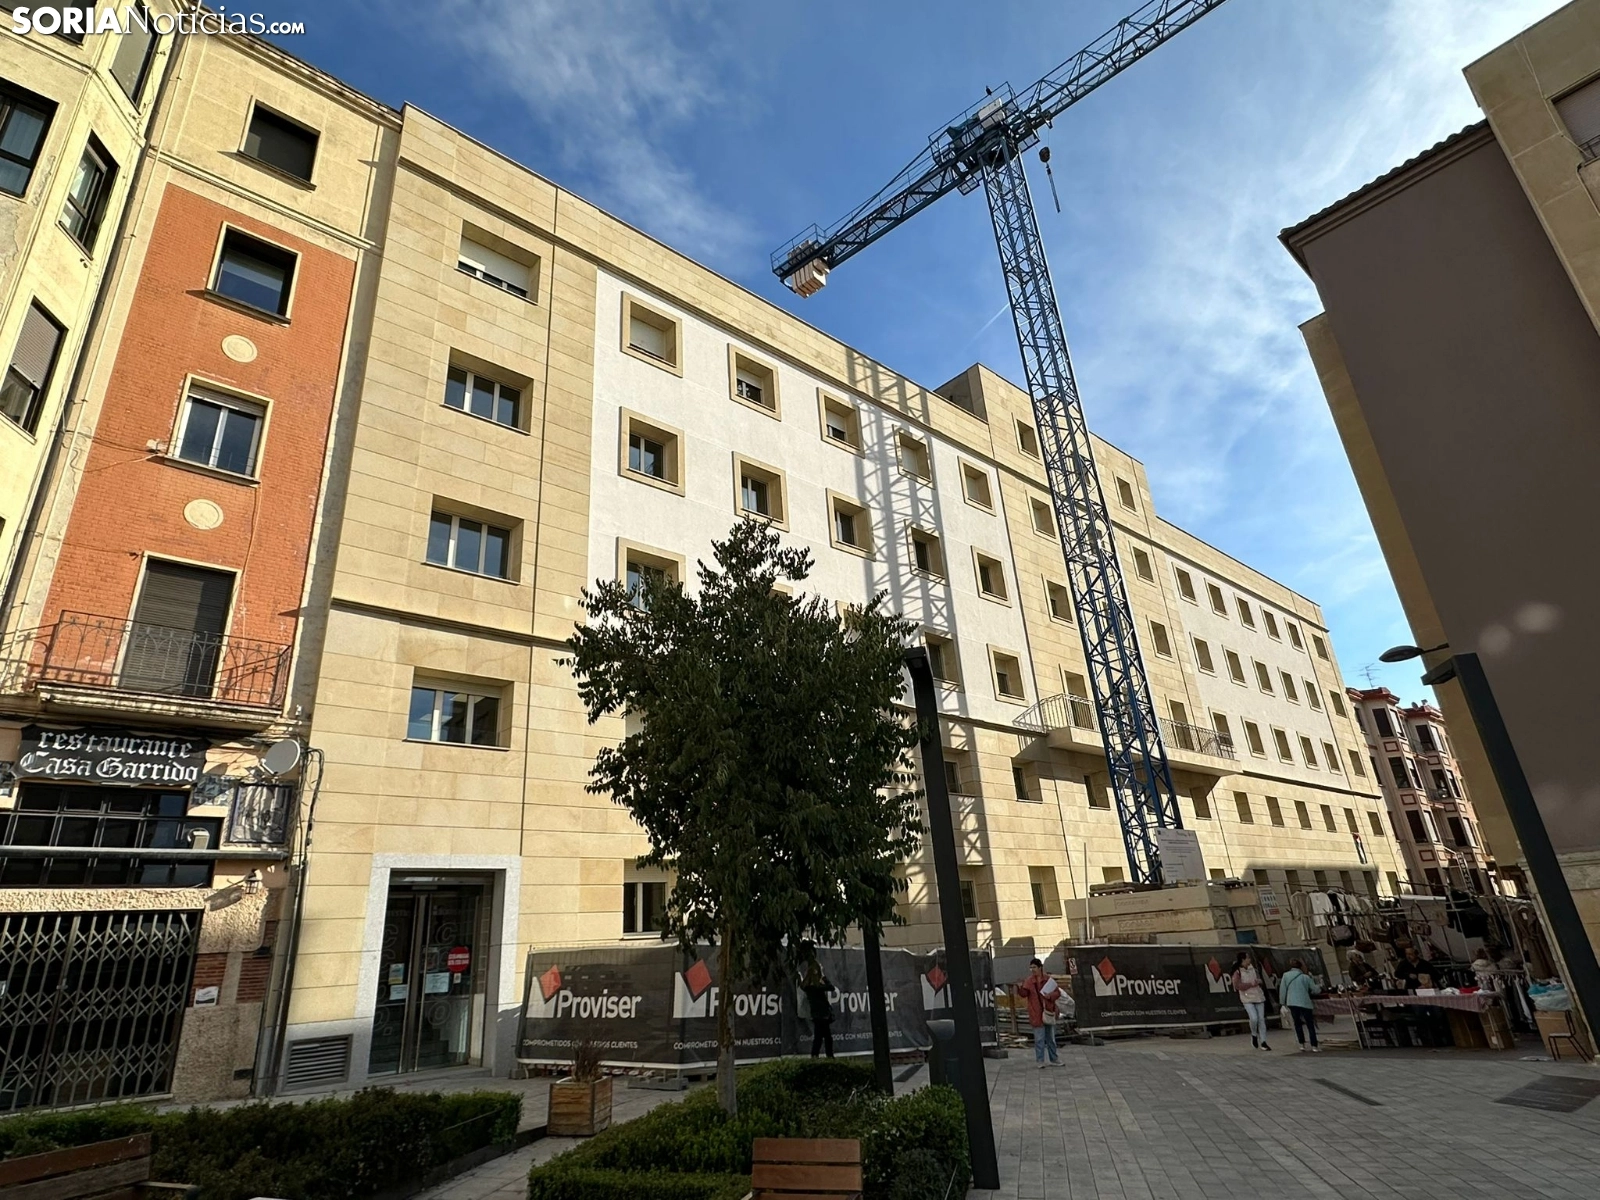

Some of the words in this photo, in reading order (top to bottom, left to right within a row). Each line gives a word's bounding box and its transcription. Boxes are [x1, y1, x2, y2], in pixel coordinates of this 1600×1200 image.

[37, 731, 193, 758] restaurante
[20, 751, 91, 776] Casa
[96, 757, 199, 782] Garrido
[1115, 974, 1181, 996] Proviser
[557, 989, 642, 1018] Proviser
[827, 985, 898, 1013] Provier
[611, 1041, 638, 1049] CLIENTES
[673, 1040, 719, 1050] COMPROMETID
[742, 1037, 774, 1046] NUESTROS
